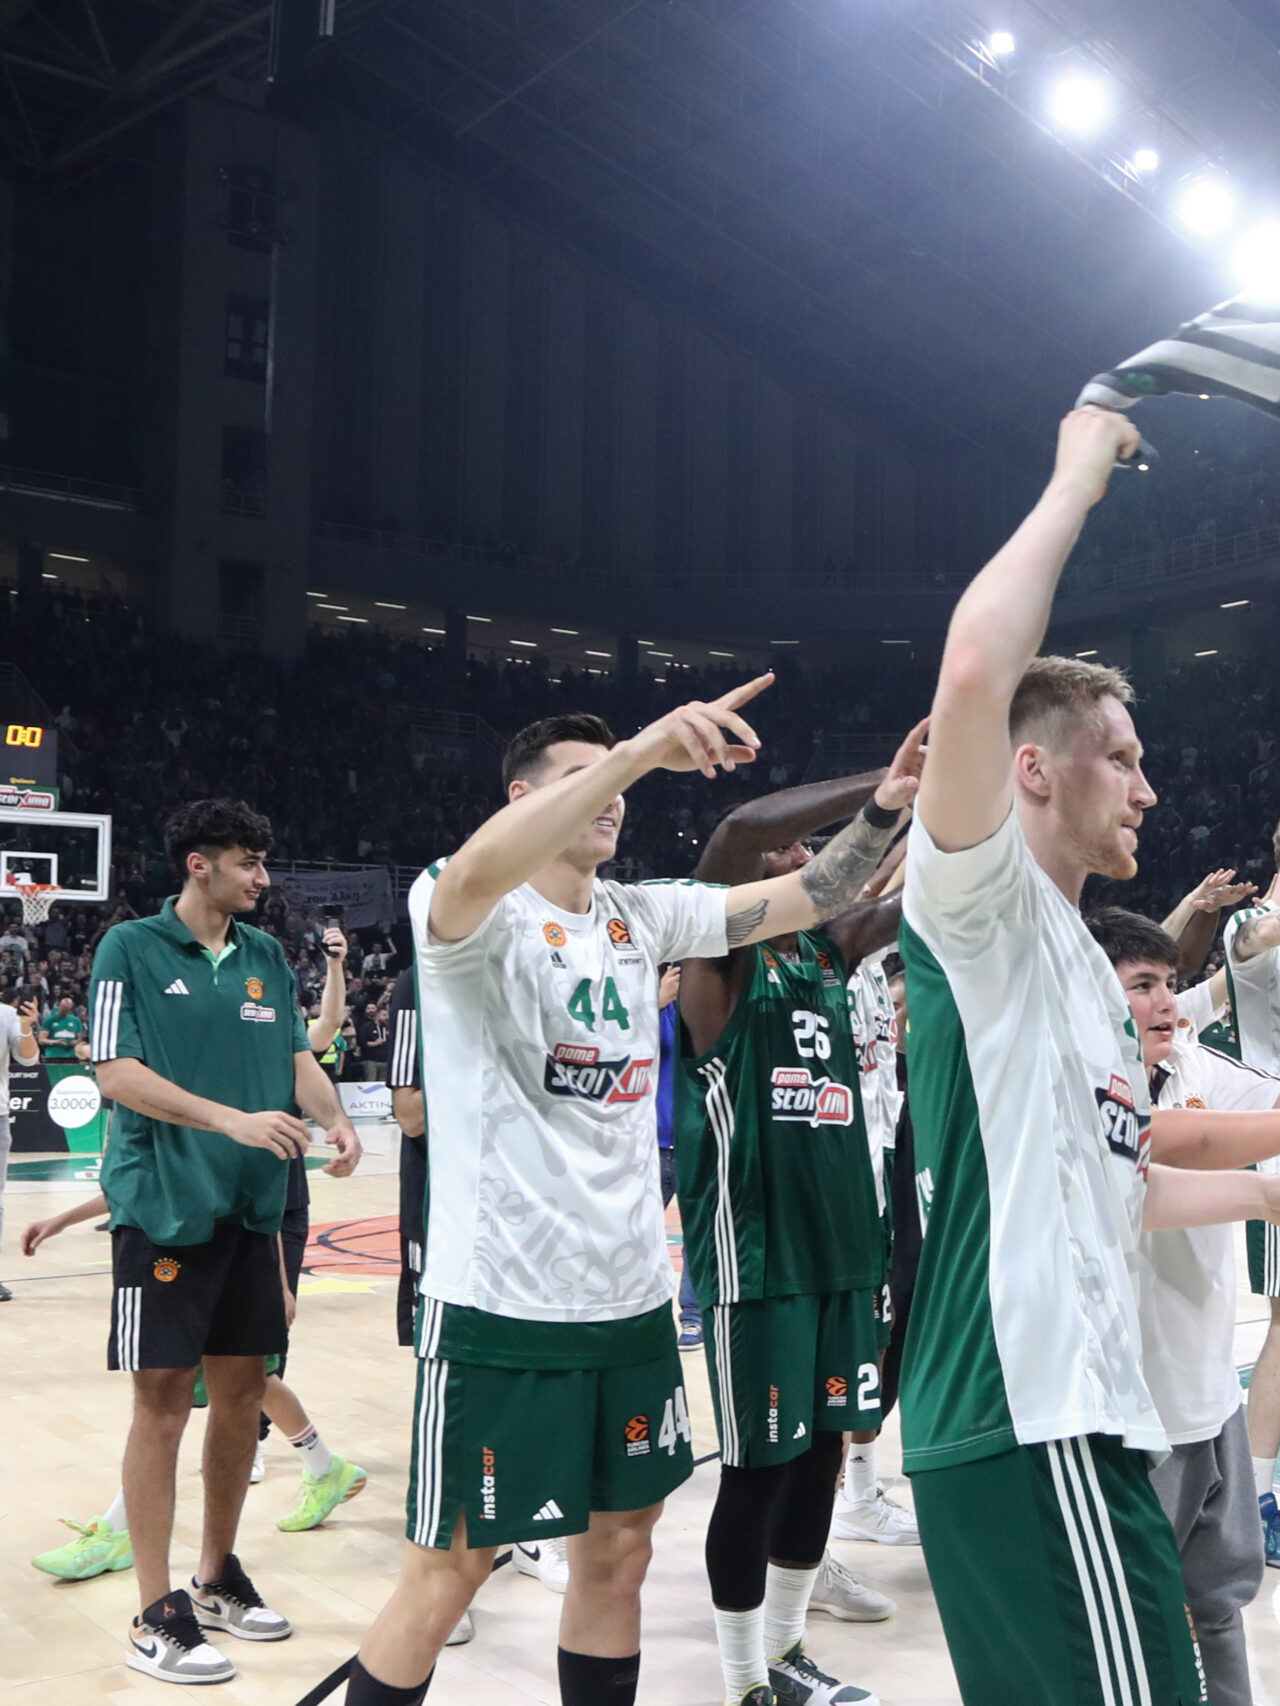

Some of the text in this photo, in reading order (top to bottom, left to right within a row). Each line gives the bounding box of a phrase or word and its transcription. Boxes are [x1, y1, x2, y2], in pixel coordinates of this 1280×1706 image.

[568, 976, 631, 1033] 44
[557, 1048, 595, 1063] pame
[792, 1010, 831, 1060] 26
[50, 1097, 97, 1110] 3.000€
[552, 1063, 653, 1096] stoixim
[777, 1073, 807, 1085] pame
[658, 1386, 692, 1456] 44
[767, 1384, 779, 1443] instacar
[480, 1446, 496, 1520] instacar
